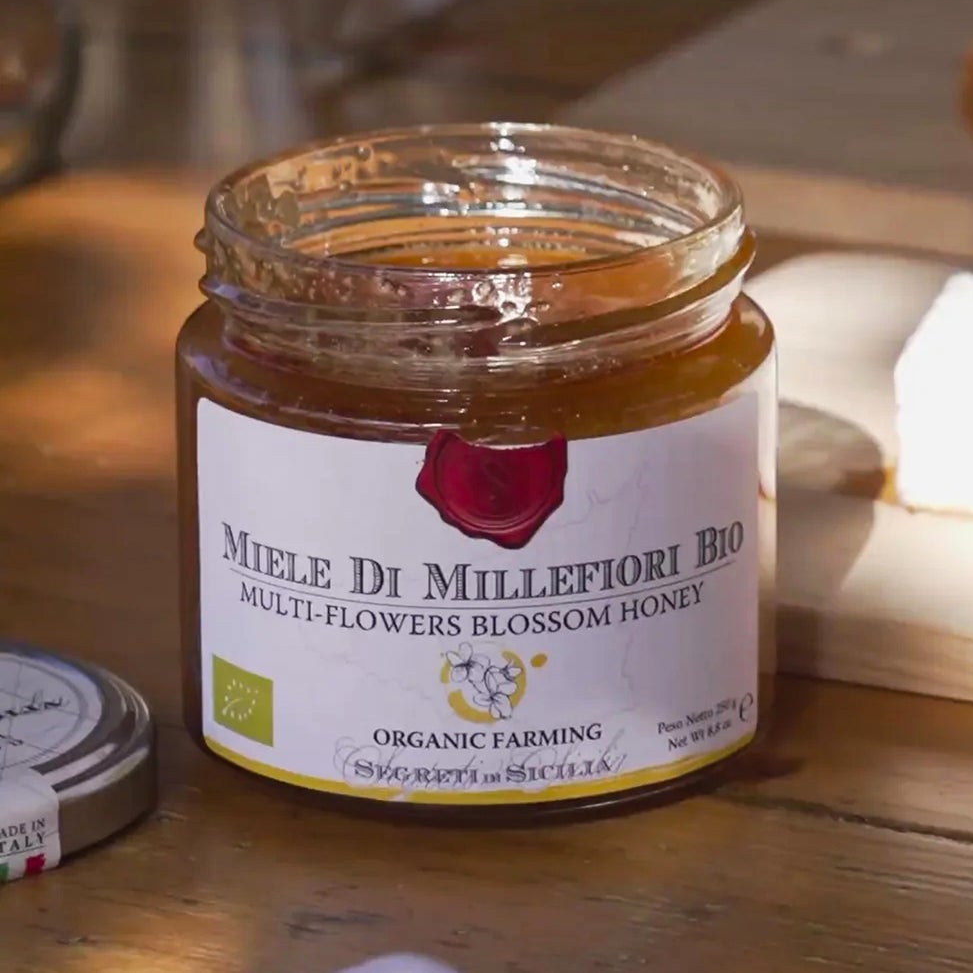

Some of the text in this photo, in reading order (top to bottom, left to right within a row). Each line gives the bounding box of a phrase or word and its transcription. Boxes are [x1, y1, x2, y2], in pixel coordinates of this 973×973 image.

[240, 581, 704, 637] MULTI-FLOWERS BLOSSOM HONEY
[373, 723, 602, 749] ORGANIC FARMING
[0, 817, 46, 838] ADE IN
[0, 831, 46, 853] TALY
